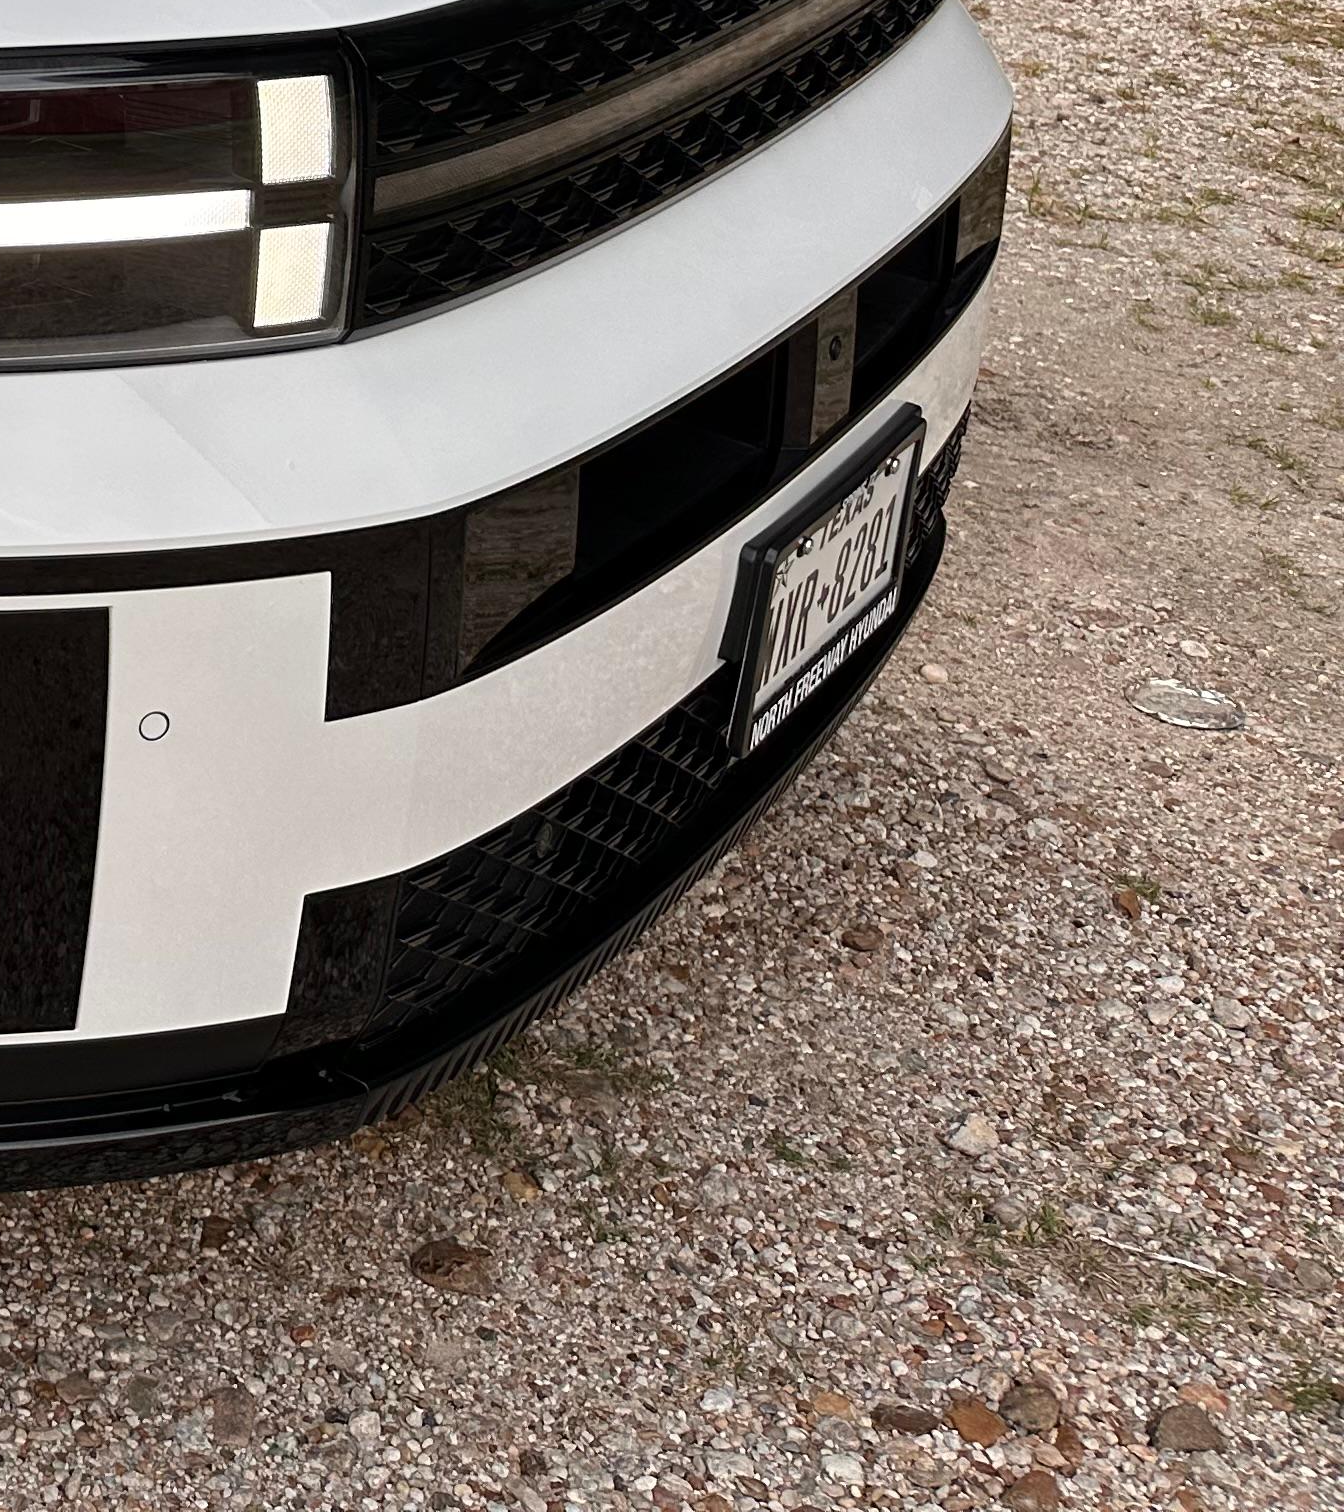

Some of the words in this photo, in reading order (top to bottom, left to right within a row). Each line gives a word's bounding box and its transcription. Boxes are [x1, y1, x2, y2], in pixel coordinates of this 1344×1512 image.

[819, 485, 874, 550] TEXAS
[749, 687, 794, 751] NORTH
[793, 633, 849, 709] FREEWAY
[848, 586, 898, 655] HYUNDAI
